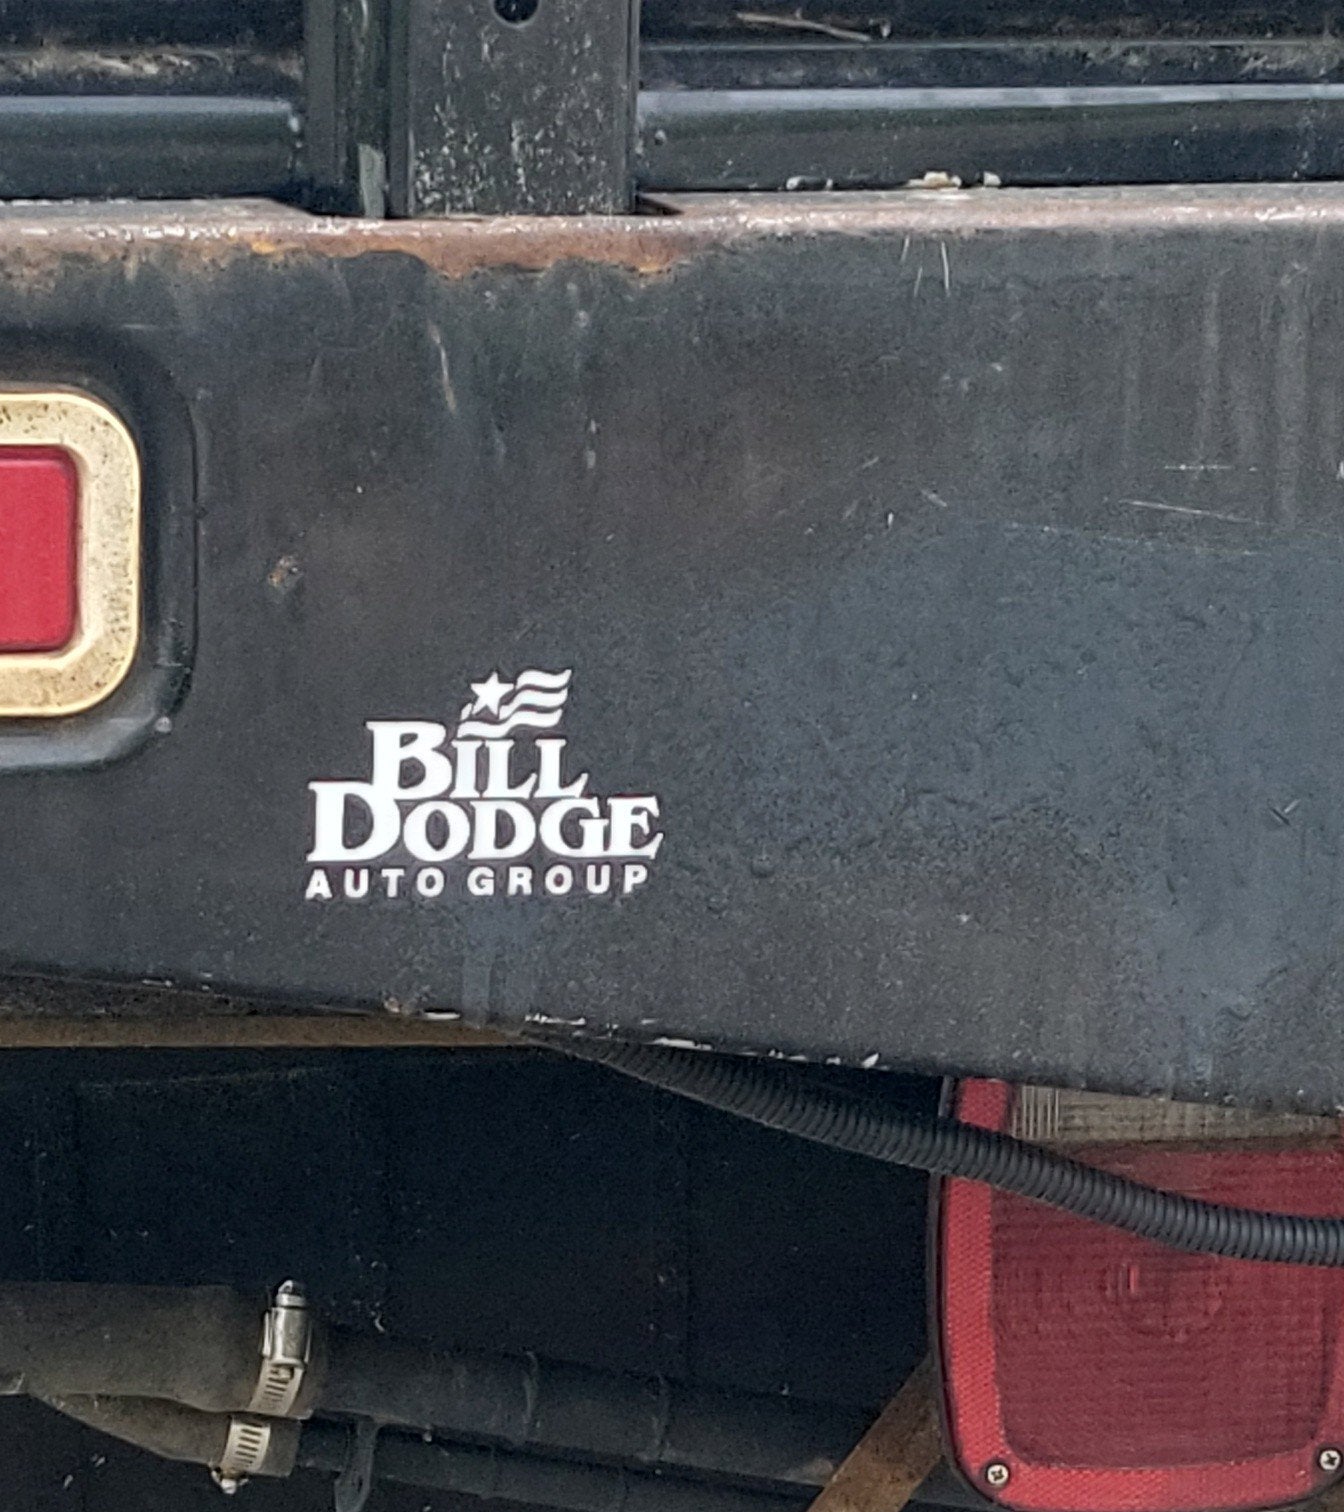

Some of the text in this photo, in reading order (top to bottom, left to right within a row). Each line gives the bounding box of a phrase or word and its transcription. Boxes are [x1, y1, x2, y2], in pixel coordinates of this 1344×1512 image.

[365, 720, 589, 799] BILL
[306, 780, 664, 862] DODGE
[305, 864, 649, 900] AUTO GROUP
